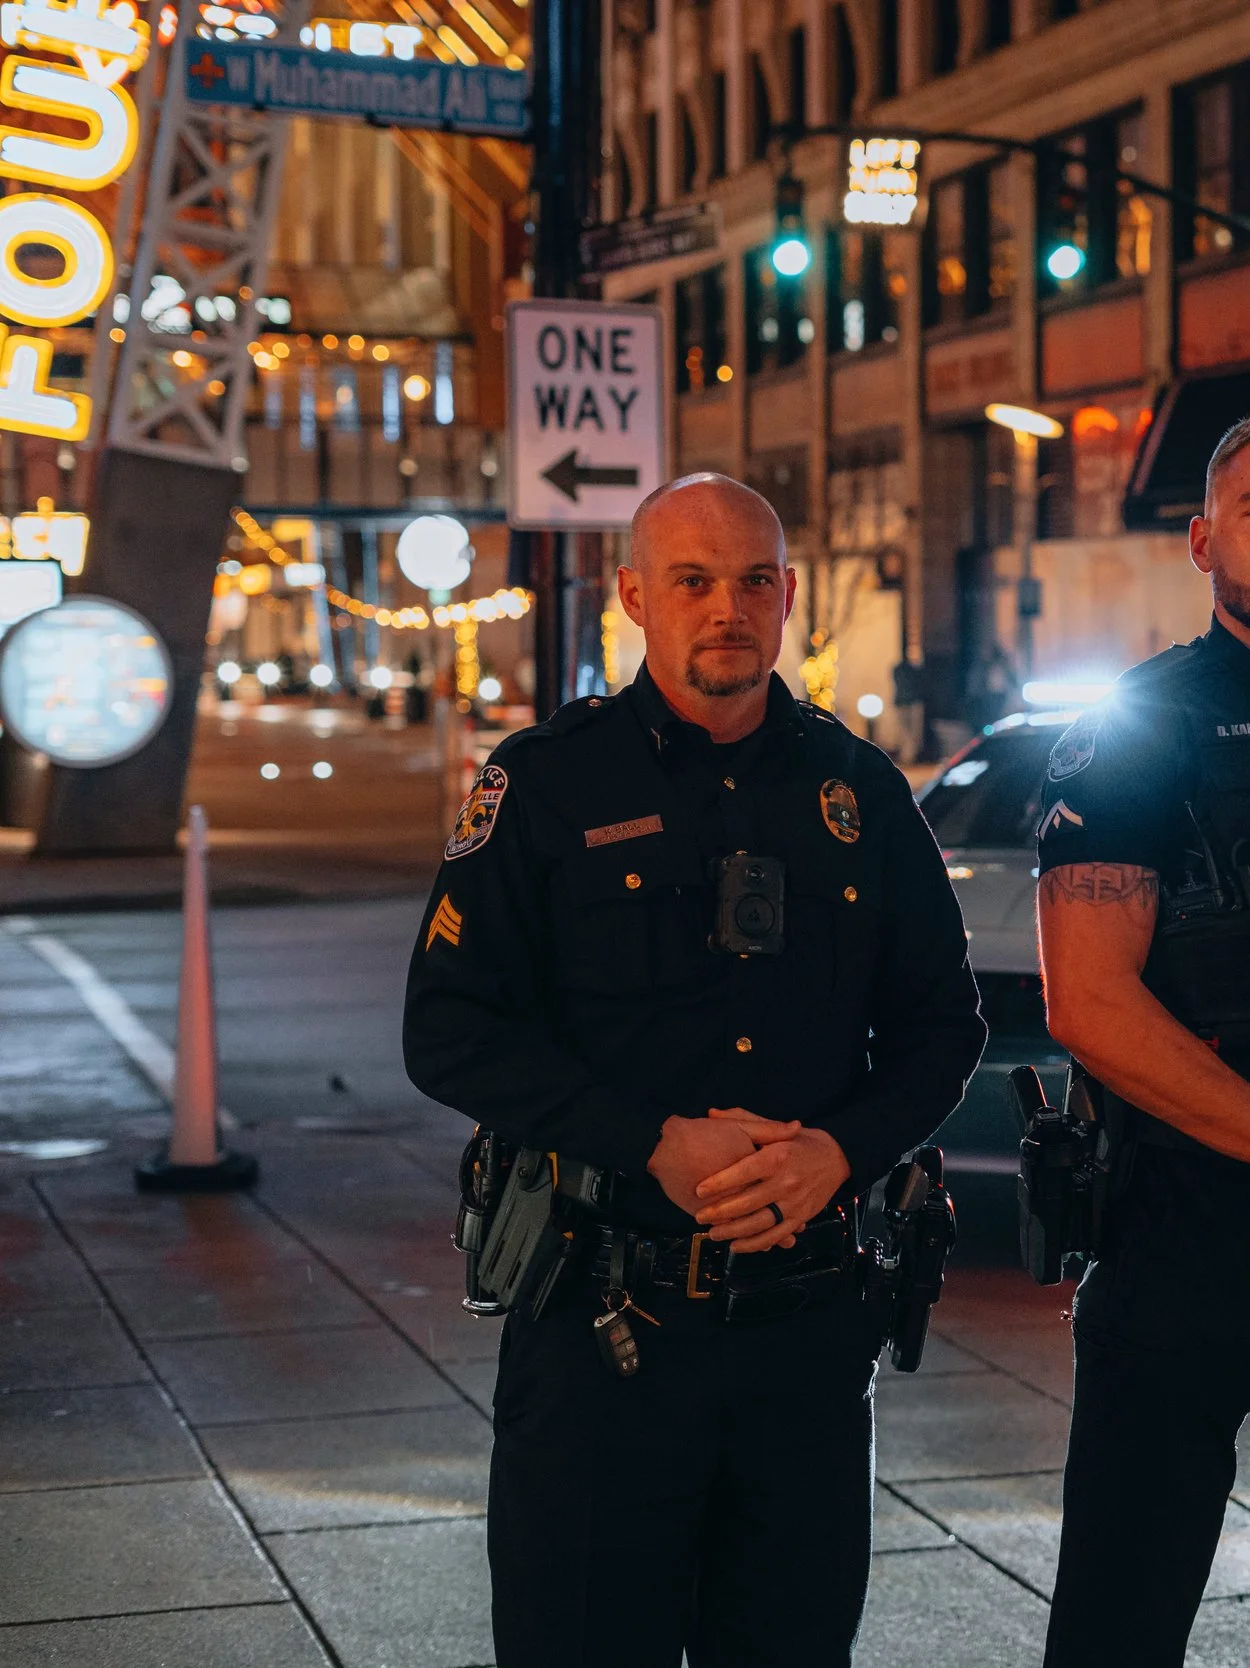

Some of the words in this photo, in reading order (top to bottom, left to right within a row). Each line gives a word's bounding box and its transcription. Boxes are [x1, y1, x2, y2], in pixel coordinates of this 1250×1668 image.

[253, 50, 441, 116] Muhammad
[443, 69, 488, 119] Ali
[537, 323, 635, 375] ONE
[534, 383, 640, 432] WAY
[1216, 725, 1230, 737] D.
